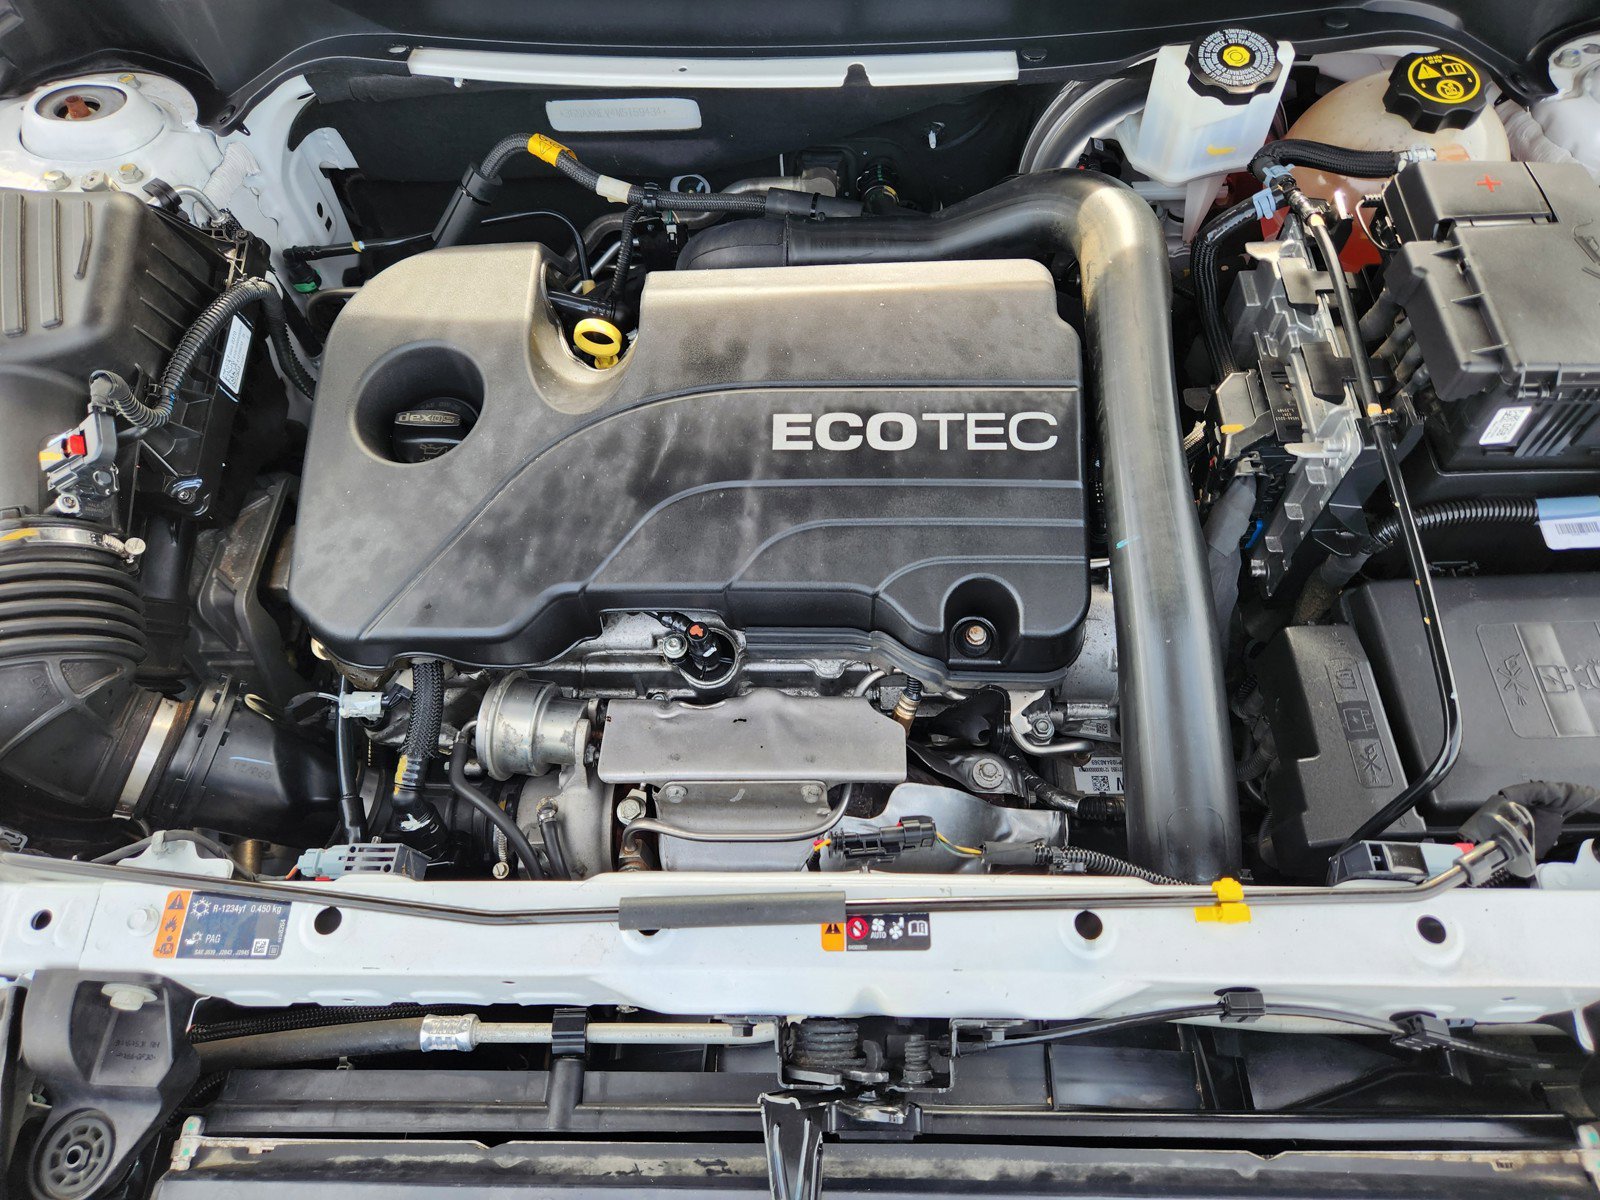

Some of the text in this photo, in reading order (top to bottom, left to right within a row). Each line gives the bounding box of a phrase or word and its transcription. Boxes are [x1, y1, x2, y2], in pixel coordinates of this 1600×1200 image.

[398, 412, 455, 424] dexos
[772, 412, 1059, 451] ECOTEC
[212, 904, 282, 915] R-1234yf 0.450 kg
[205, 934, 221, 944] PAG
[870, 931, 887, 939] AUTO
